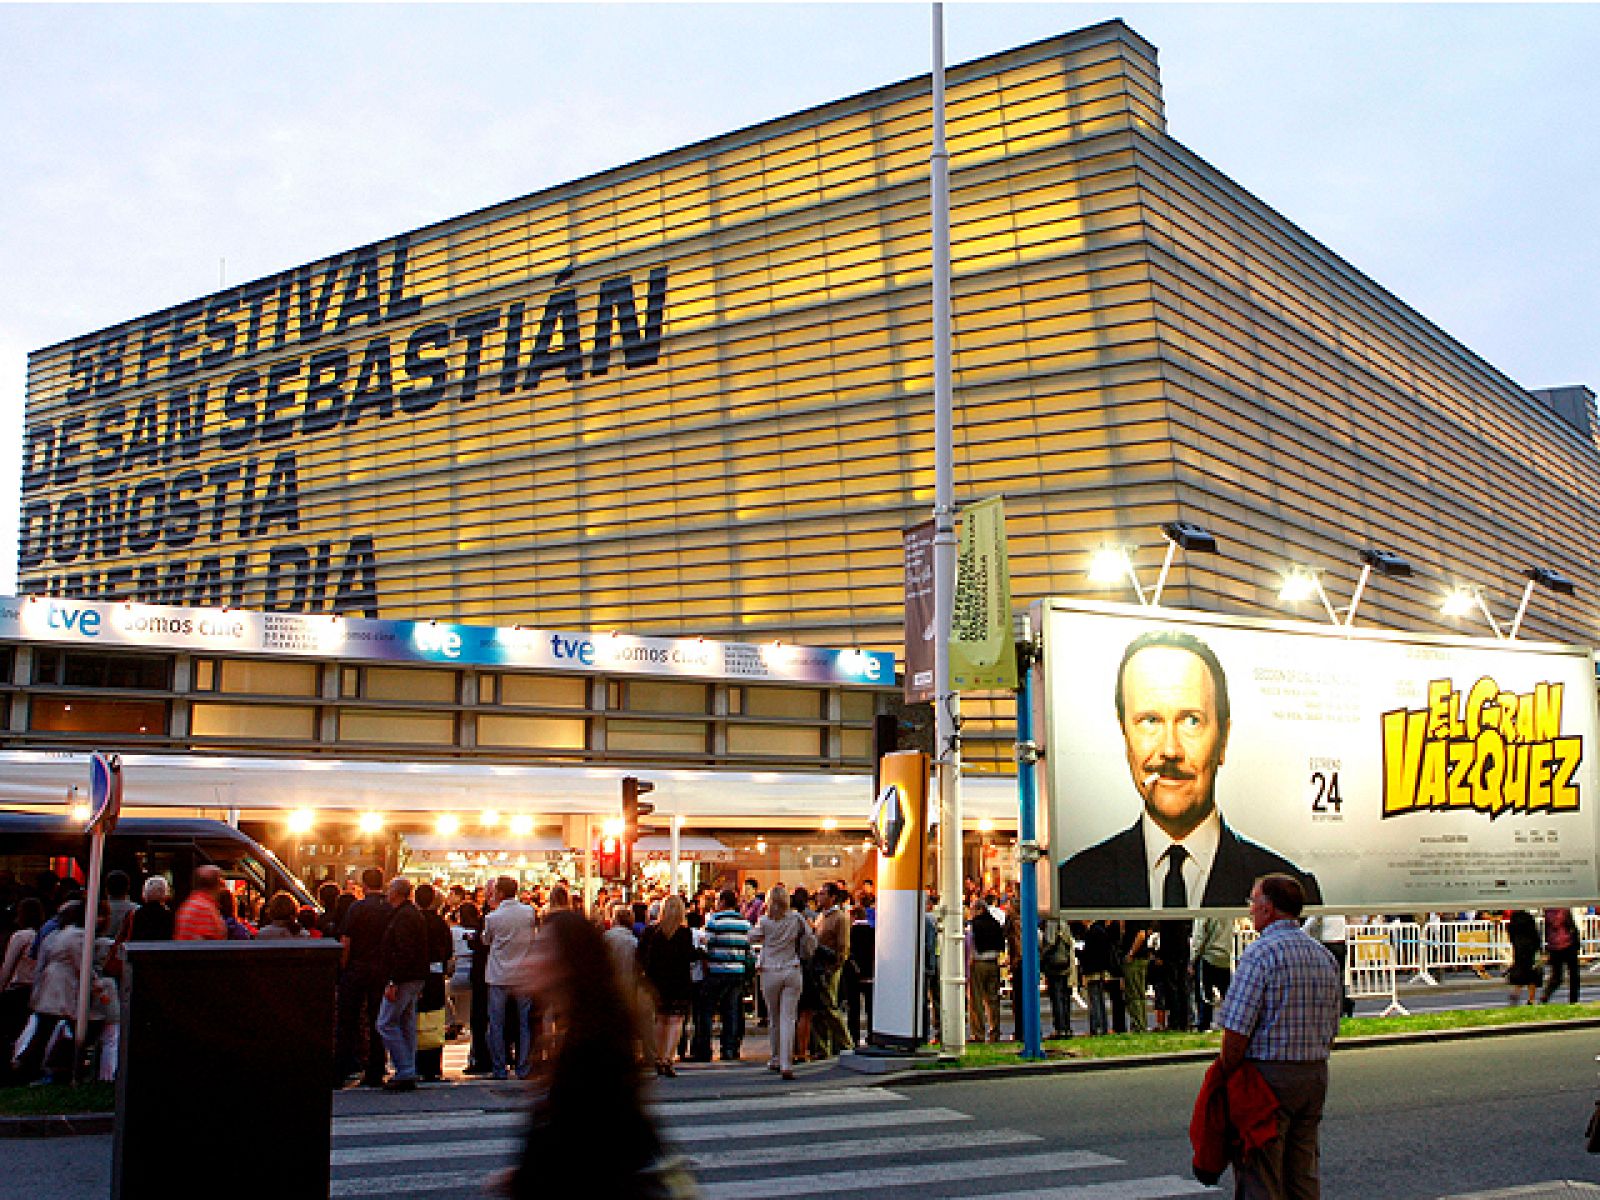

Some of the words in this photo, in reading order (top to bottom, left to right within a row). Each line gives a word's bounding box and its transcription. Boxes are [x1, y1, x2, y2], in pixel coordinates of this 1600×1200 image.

[136, 236, 421, 390] FESTIVAL
[24, 414, 87, 491] DE
[92, 382, 209, 477] SAN
[218, 262, 669, 450] SEBASTIÁN
[20, 450, 300, 566] DONOSTIA
[48, 603, 101, 637] tve
[551, 634, 595, 666] tve
[1427, 677, 1467, 742] EL
[1466, 675, 1565, 744] GRAN
[1310, 771, 1343, 813] 24
